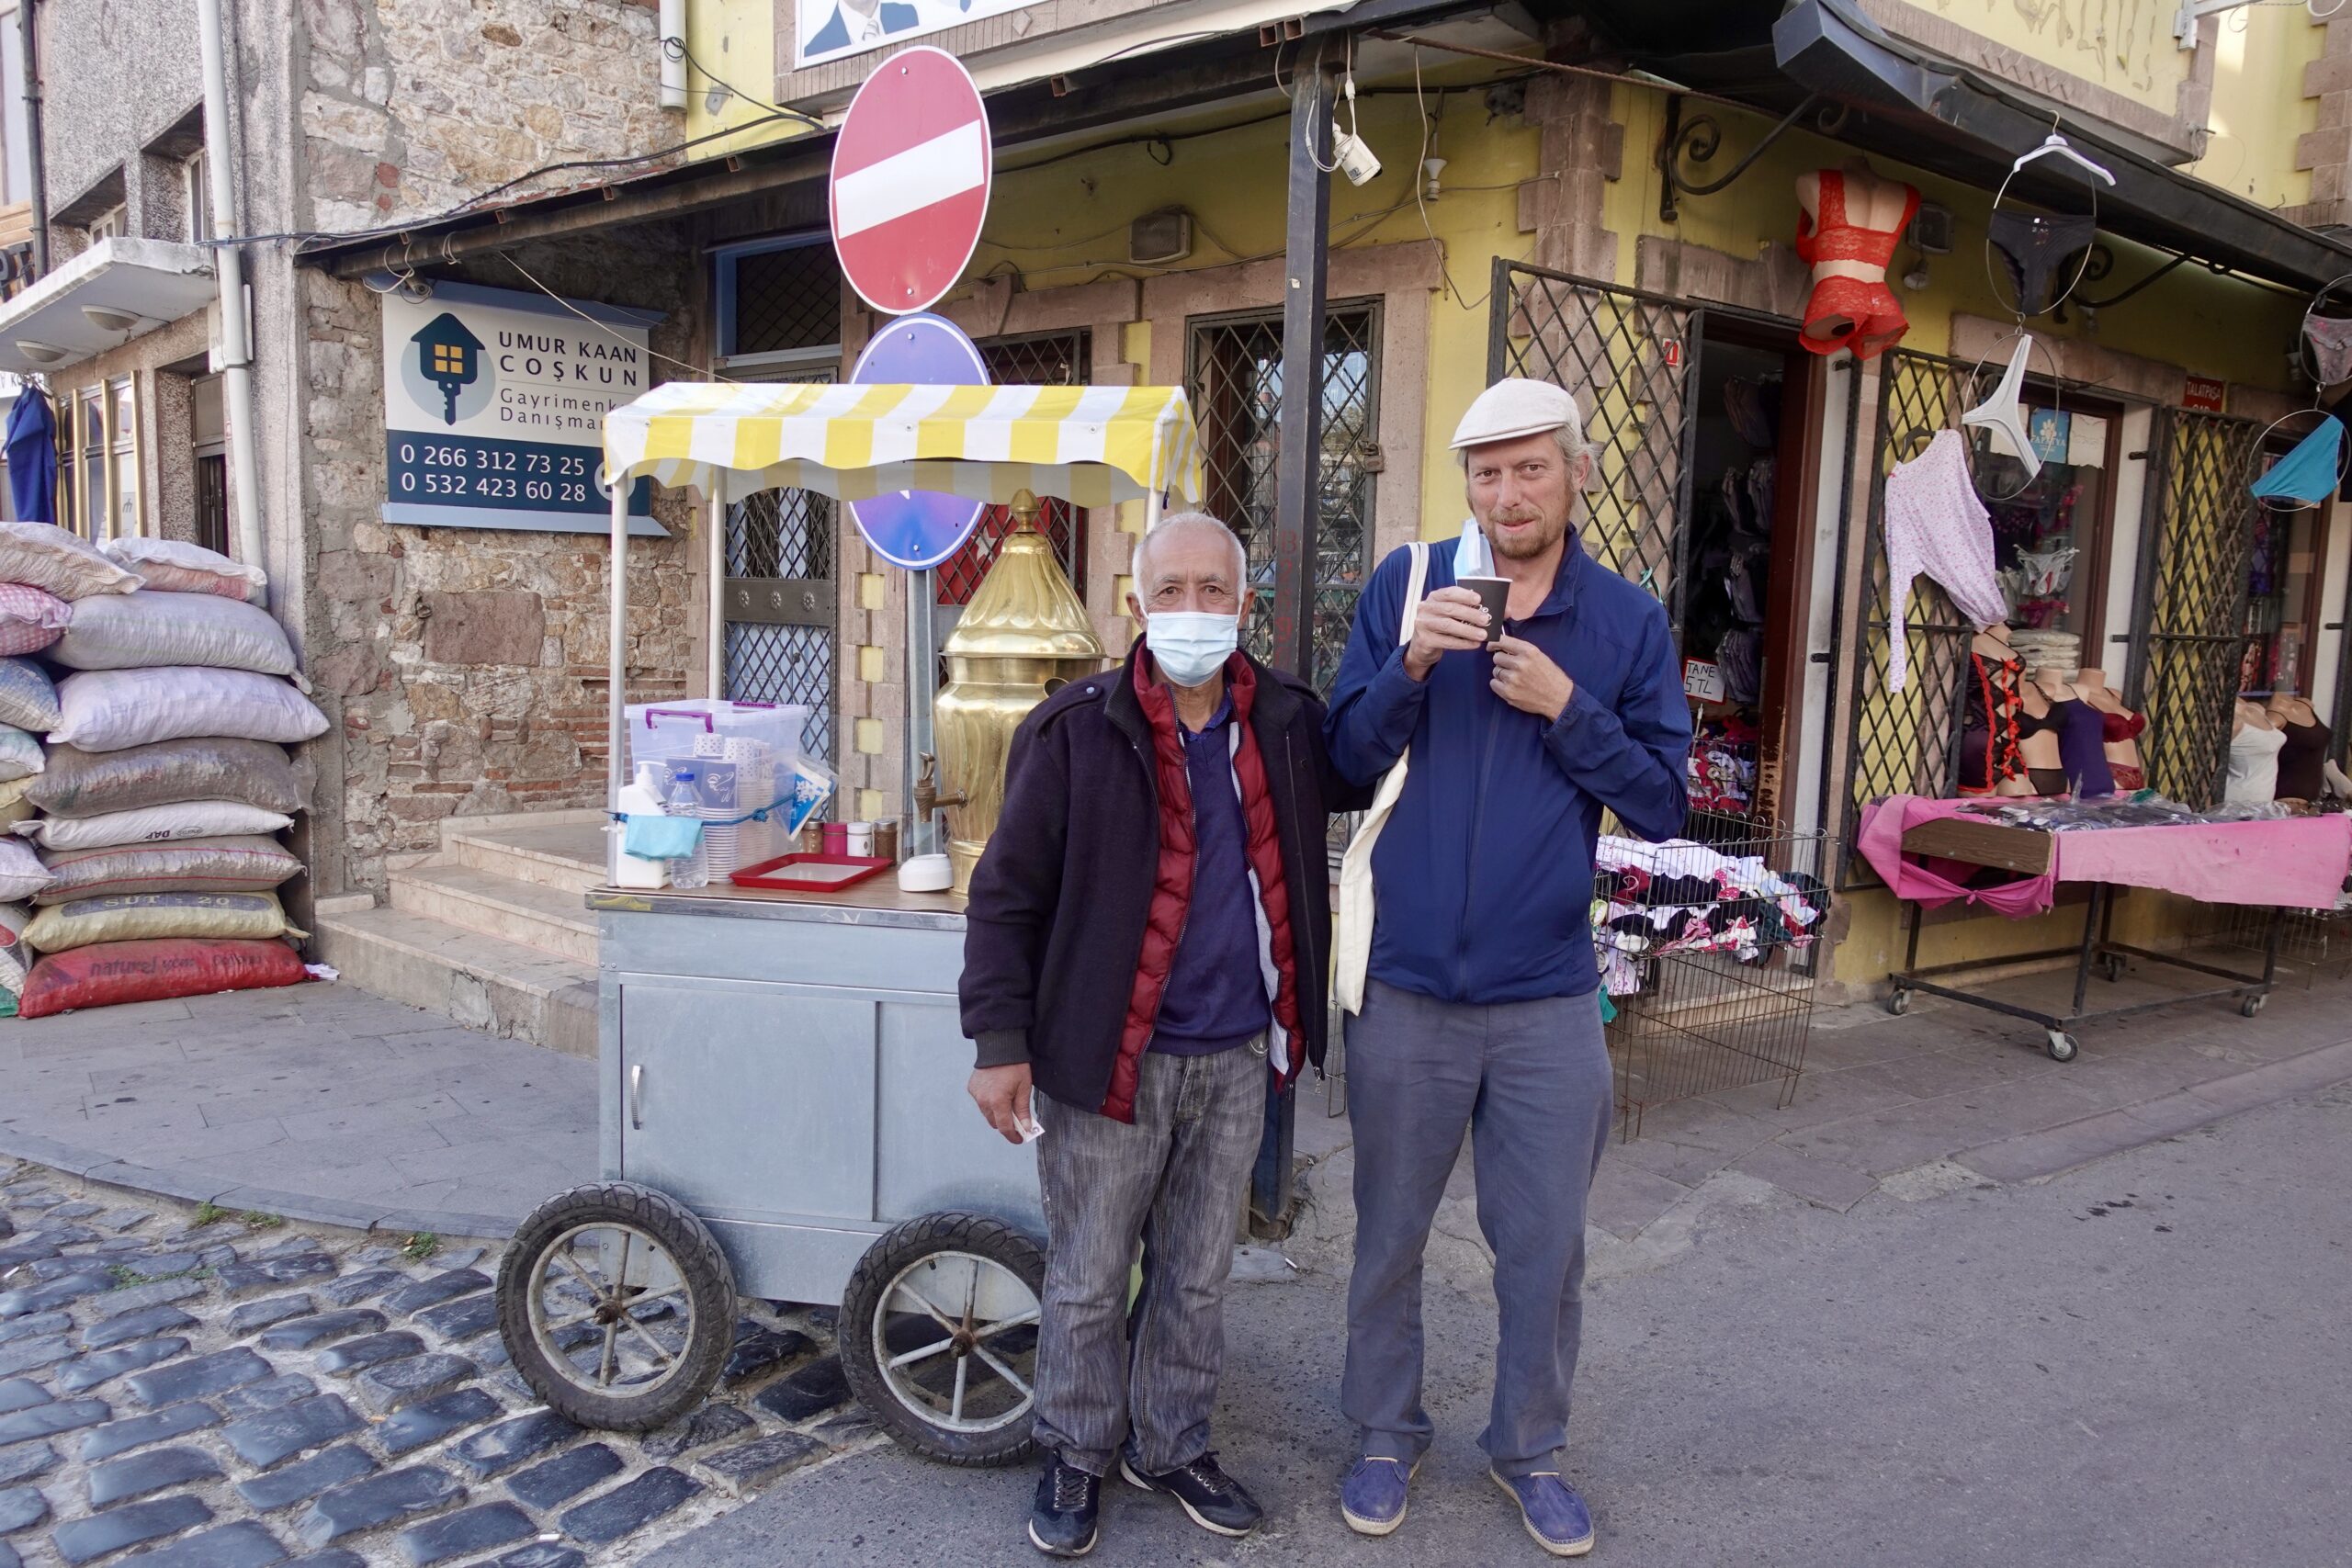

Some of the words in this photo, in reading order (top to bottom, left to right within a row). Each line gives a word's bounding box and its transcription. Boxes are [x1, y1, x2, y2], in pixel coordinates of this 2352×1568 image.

[499, 331, 566, 355] UMUR
[579, 341, 637, 364] KAAN
[500, 355, 637, 387] COŞKUN
[500, 388, 625, 412] Gayrimenk
[401, 444, 415, 464] 0
[424, 446, 468, 468] 266
[476, 449, 516, 471] 312
[526, 454, 551, 474] 73
[560, 457, 584, 476] 25
[401, 472, 416, 491] 0
[425, 474, 467, 494] 532
[476, 478, 517, 498] 423
[526, 481, 552, 501] 60
[560, 483, 586, 502] 28
[1687, 662, 1715, 679] TANE
[1685, 675, 1695, 693] 5
[1697, 678, 1713, 694] TL
[198, 896, 231, 906] 20
[89, 956, 157, 977] naturel
